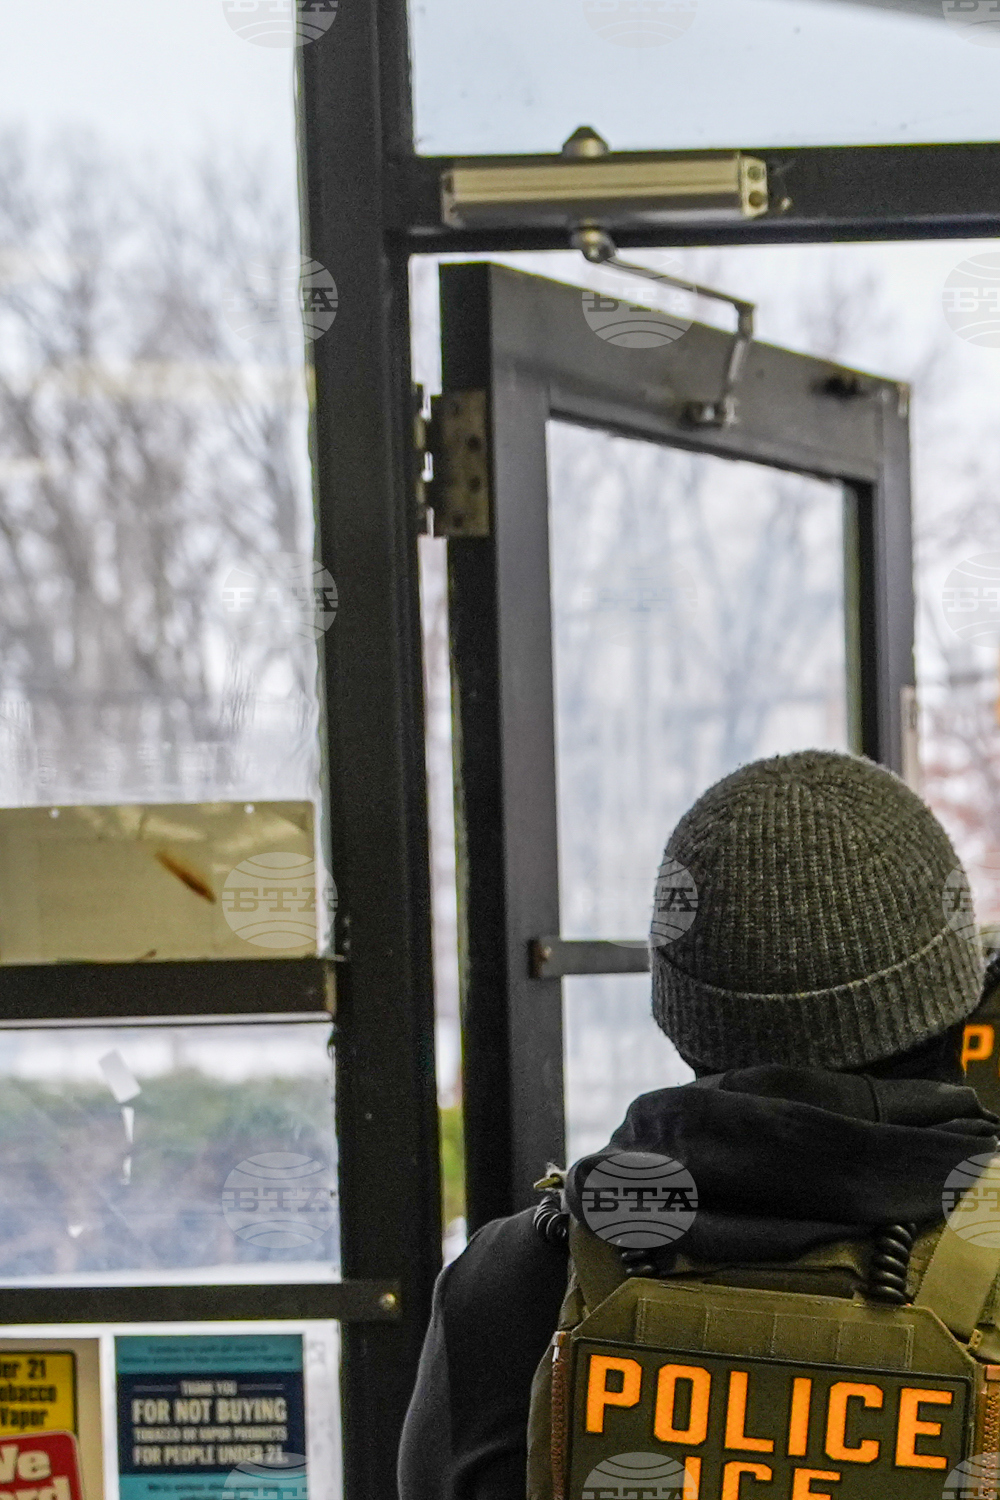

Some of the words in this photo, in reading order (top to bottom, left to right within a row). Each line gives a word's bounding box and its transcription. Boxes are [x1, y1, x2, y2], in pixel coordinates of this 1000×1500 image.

[131, 1398, 170, 1424] FOR
[173, 1398, 212, 1424] NOT
[215, 1396, 288, 1423] BUYING
[584, 1353, 954, 1471] POLICE
